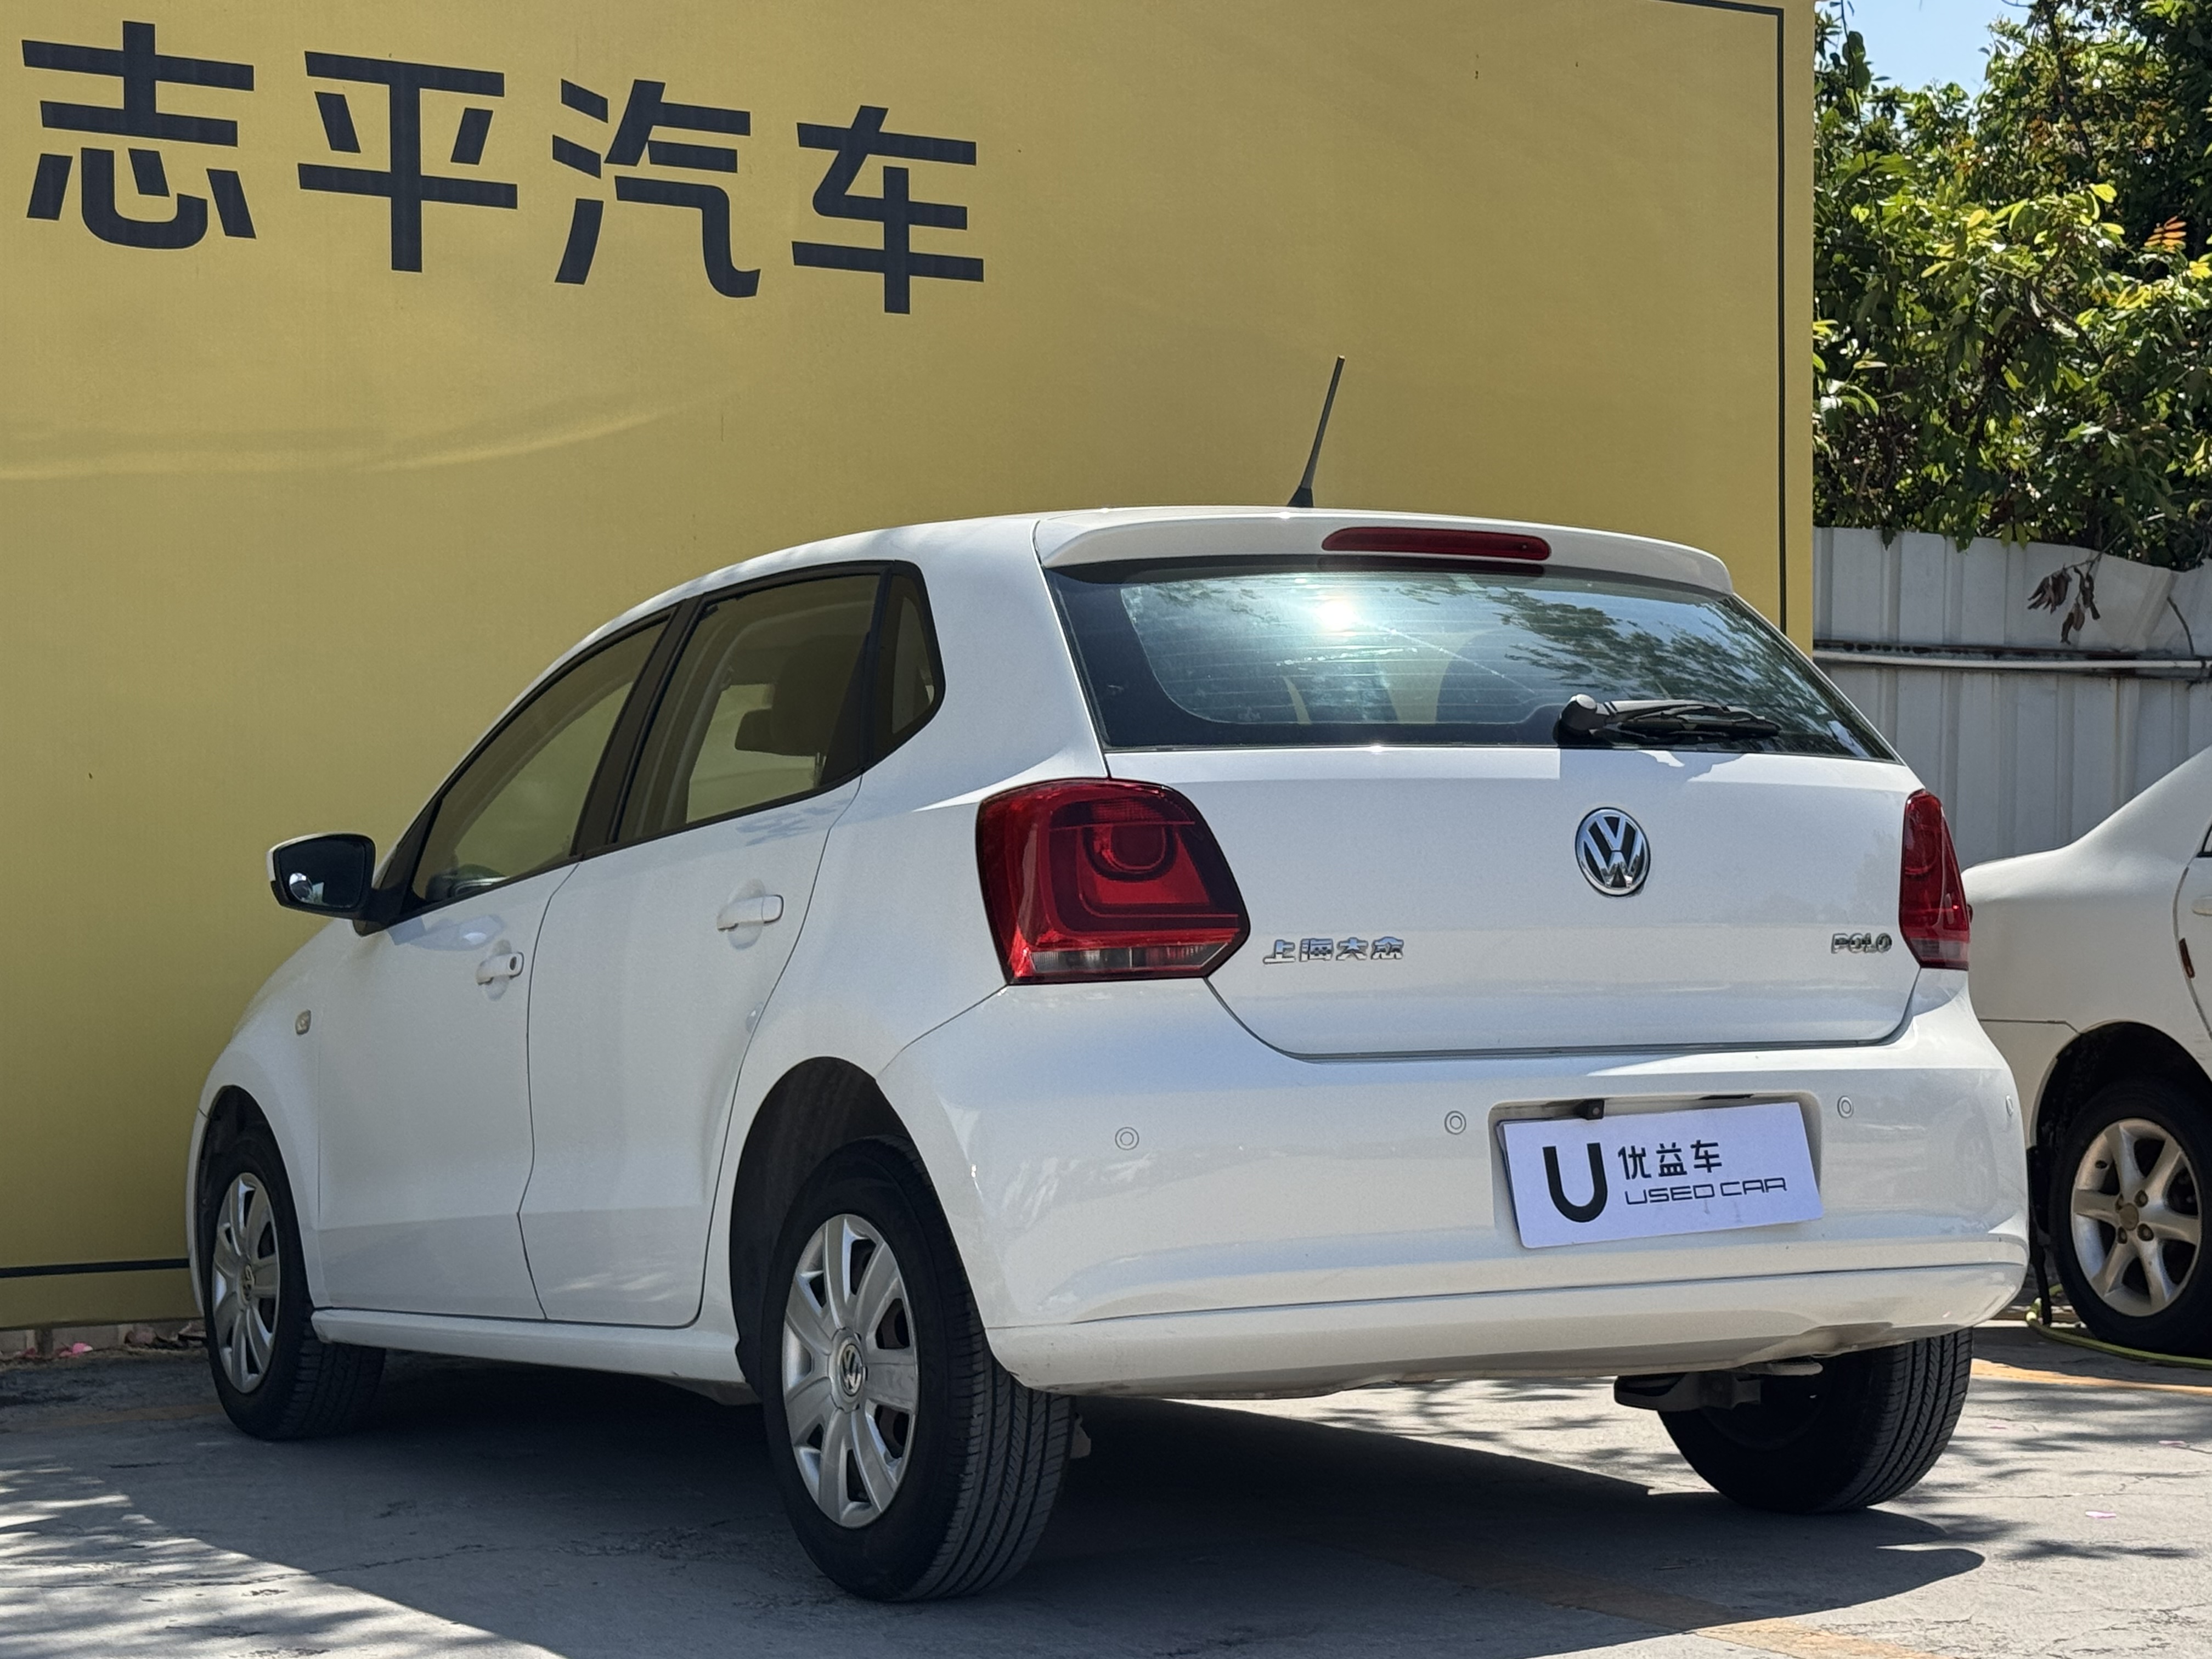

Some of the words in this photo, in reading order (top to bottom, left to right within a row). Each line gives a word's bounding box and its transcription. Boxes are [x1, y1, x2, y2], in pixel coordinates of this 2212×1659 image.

[21, 20, 984, 315] 志平汽车
[1263, 936, 1404, 964] 上海大众
[1831, 933, 1892, 954] POLO
[1618, 1139, 1723, 1181] 优益车
[1542, 1142, 1608, 1223] U
[1624, 1183, 1715, 1205] USED
[1720, 1177, 1787, 1196] CAR
